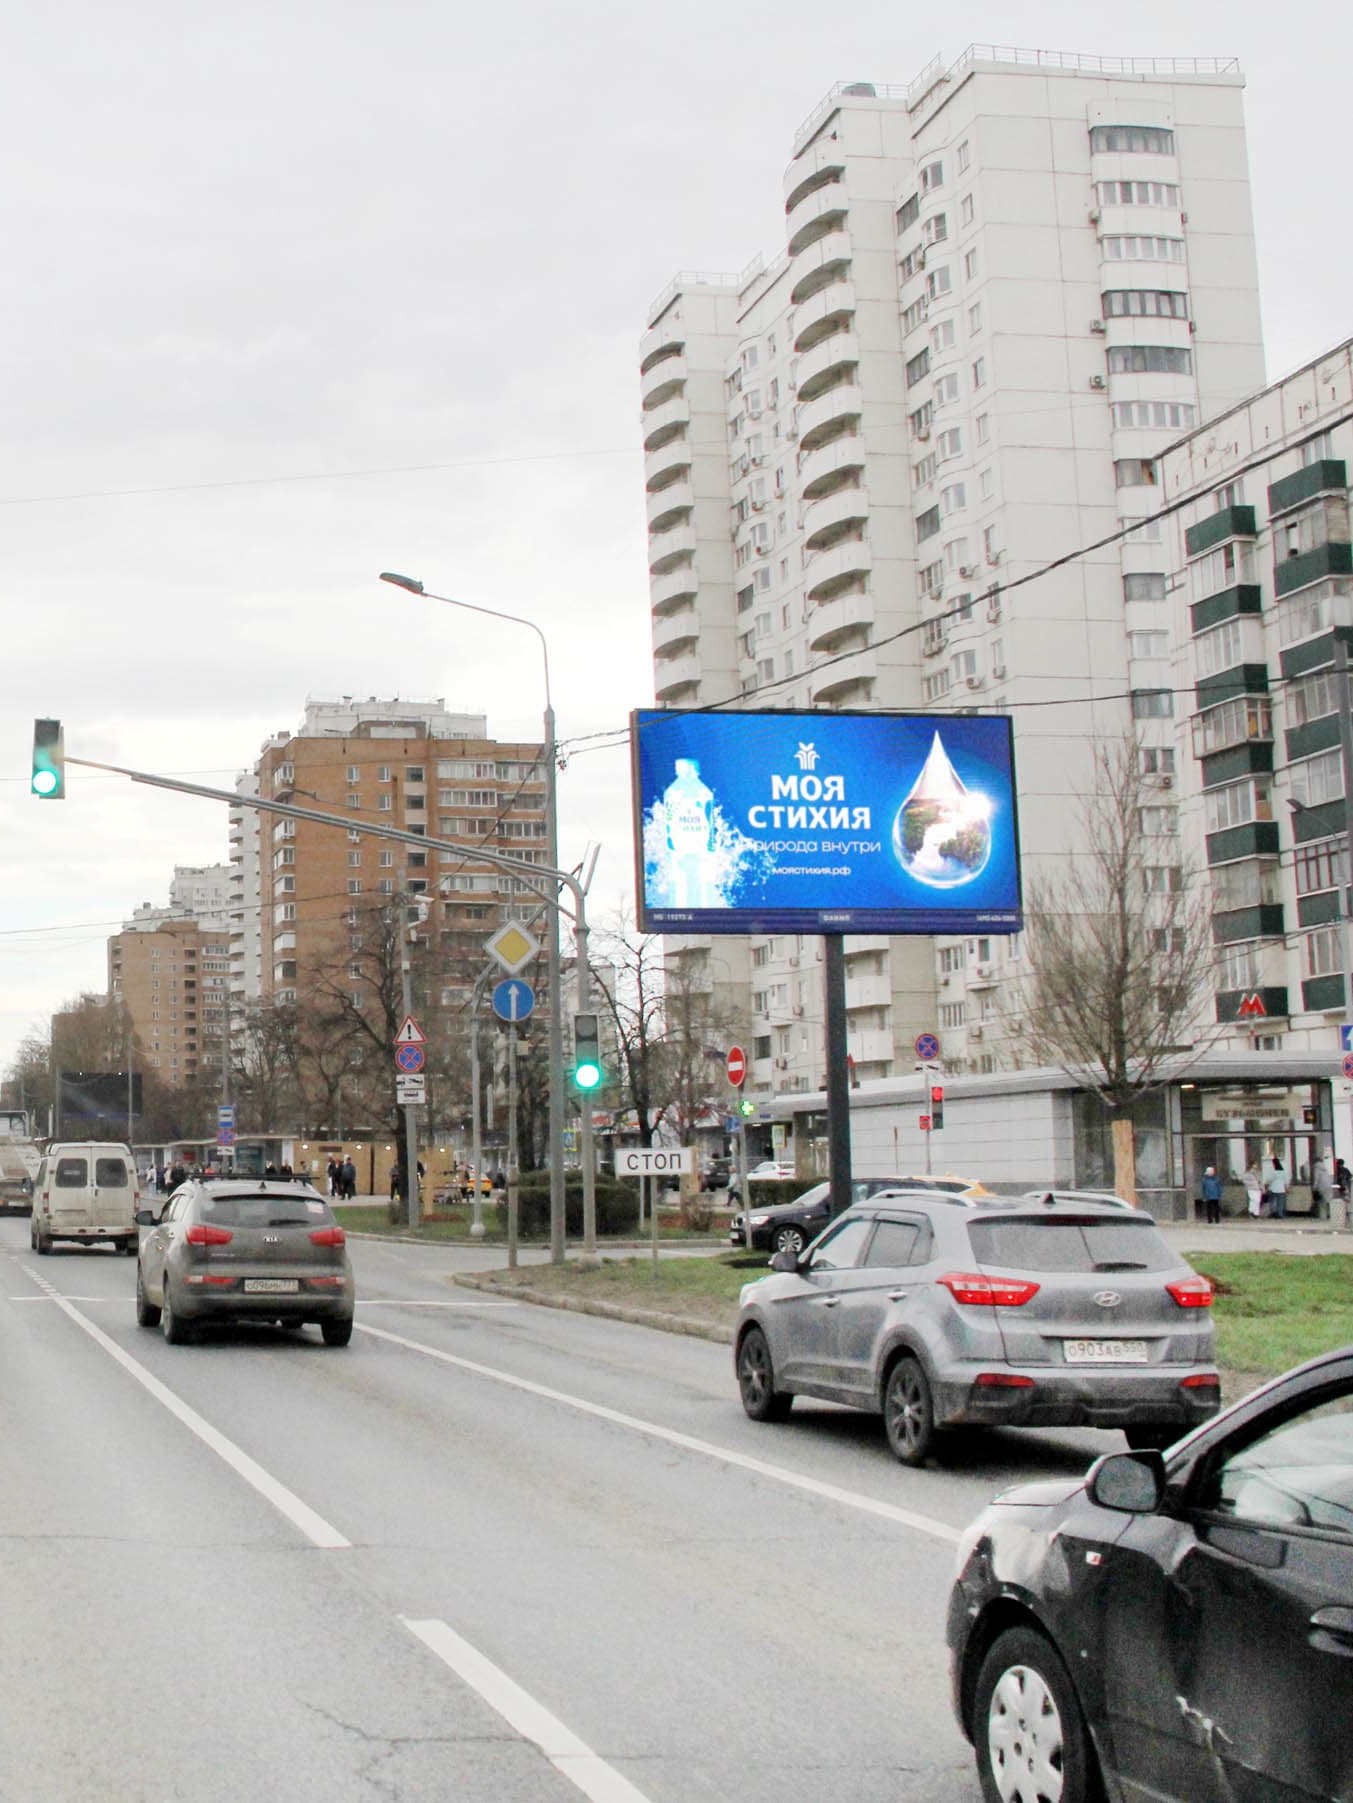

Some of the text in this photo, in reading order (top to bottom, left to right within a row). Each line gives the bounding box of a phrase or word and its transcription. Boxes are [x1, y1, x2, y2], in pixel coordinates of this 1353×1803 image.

[771, 775, 845, 801] МОЯ
[748, 805, 871, 830] СТИХИЯ
[746, 841, 881, 855] рирода внутри
[627, 1153, 682, 1170] СТОП
